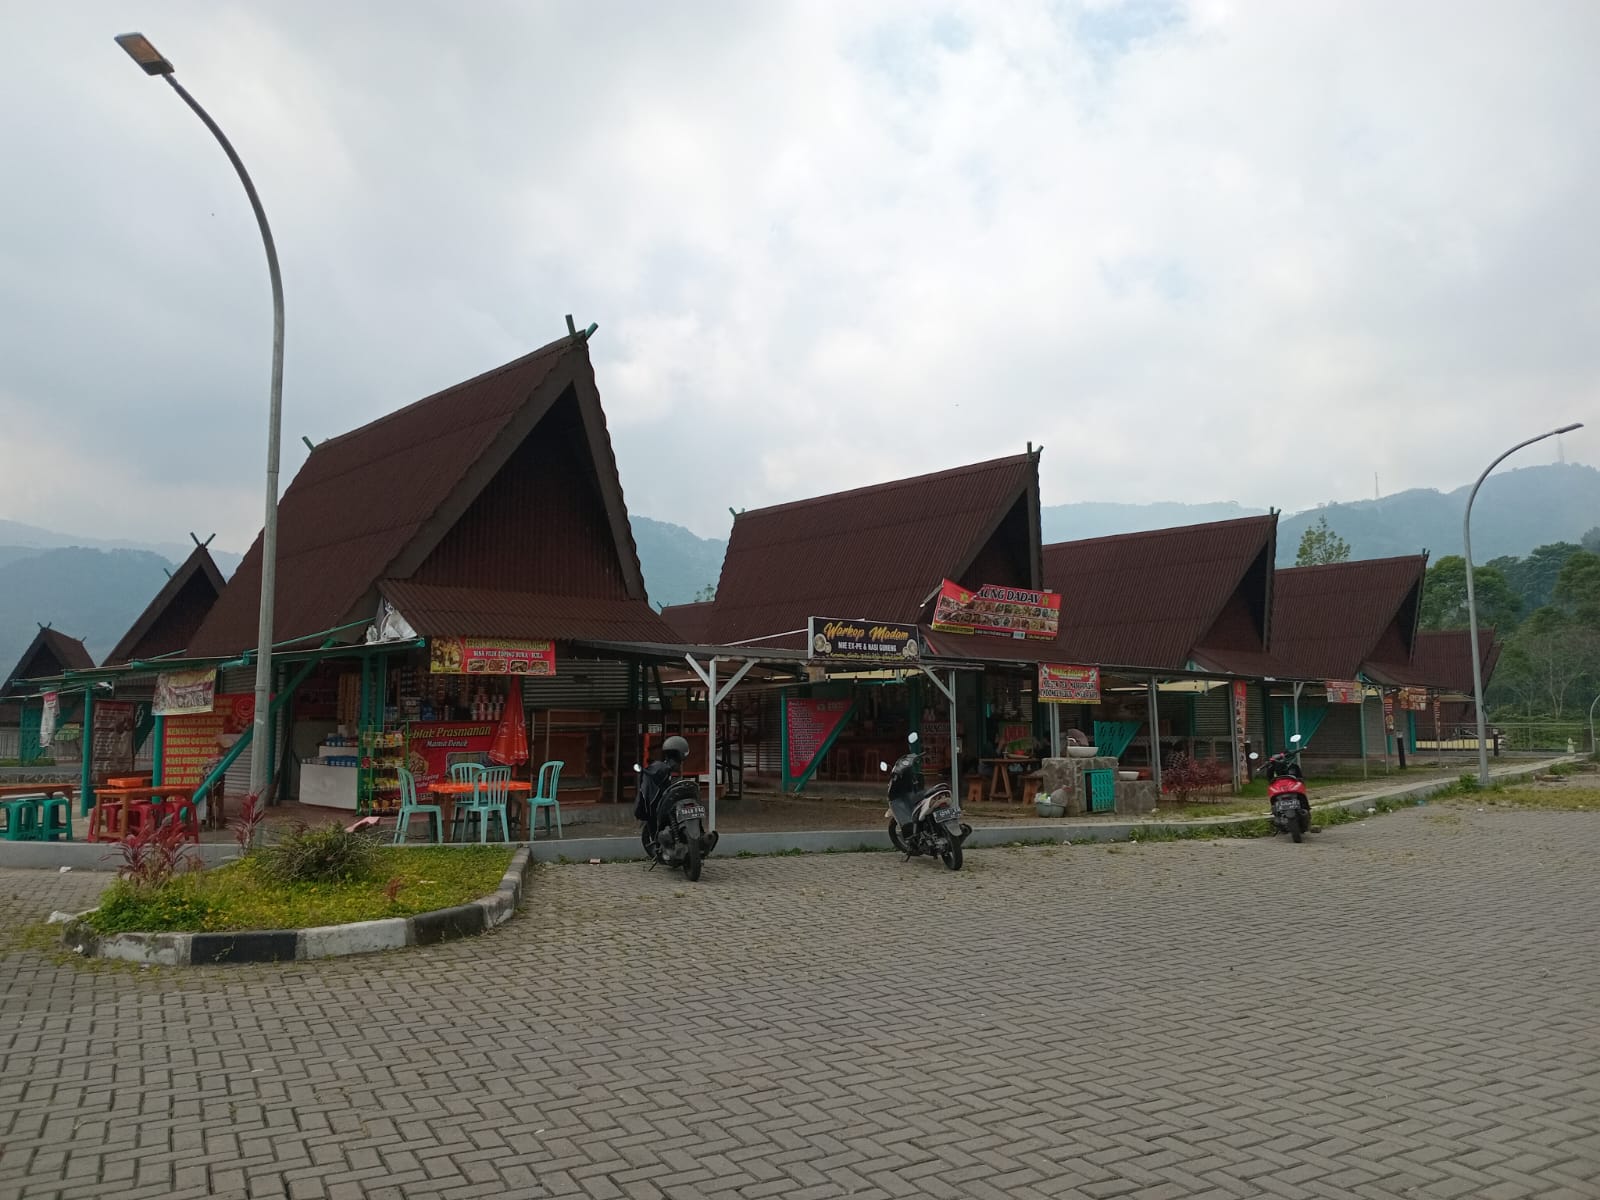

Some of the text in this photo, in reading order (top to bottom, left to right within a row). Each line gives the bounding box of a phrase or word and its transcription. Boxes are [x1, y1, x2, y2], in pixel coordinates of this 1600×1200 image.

[824, 621, 909, 642] Warkop Madam
[436, 726, 491, 737] Prasmanan
